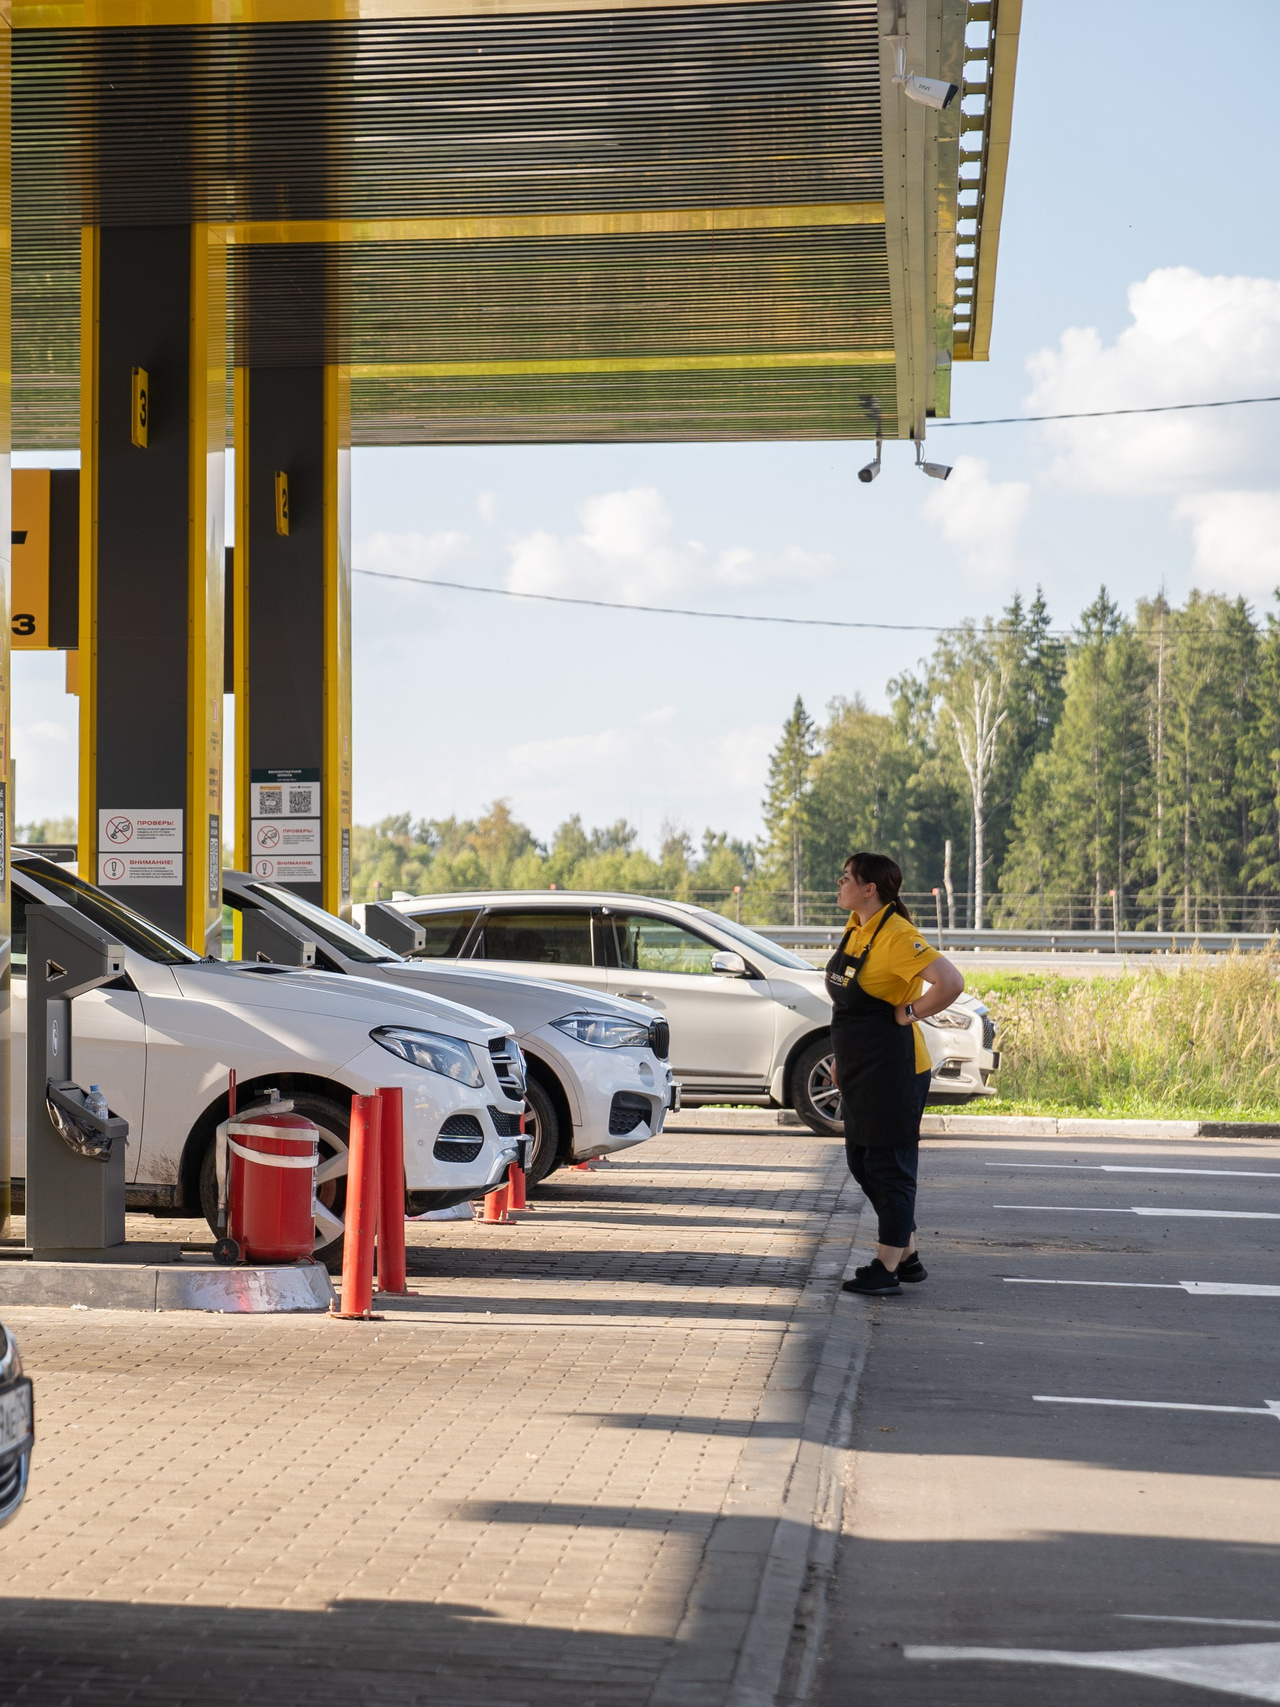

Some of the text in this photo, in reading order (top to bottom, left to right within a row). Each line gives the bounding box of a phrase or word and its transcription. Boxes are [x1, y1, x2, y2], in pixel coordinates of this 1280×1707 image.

[140, 389, 147, 428] 3
[282, 488, 288, 520] 2
[11, 613, 36, 636] 3
